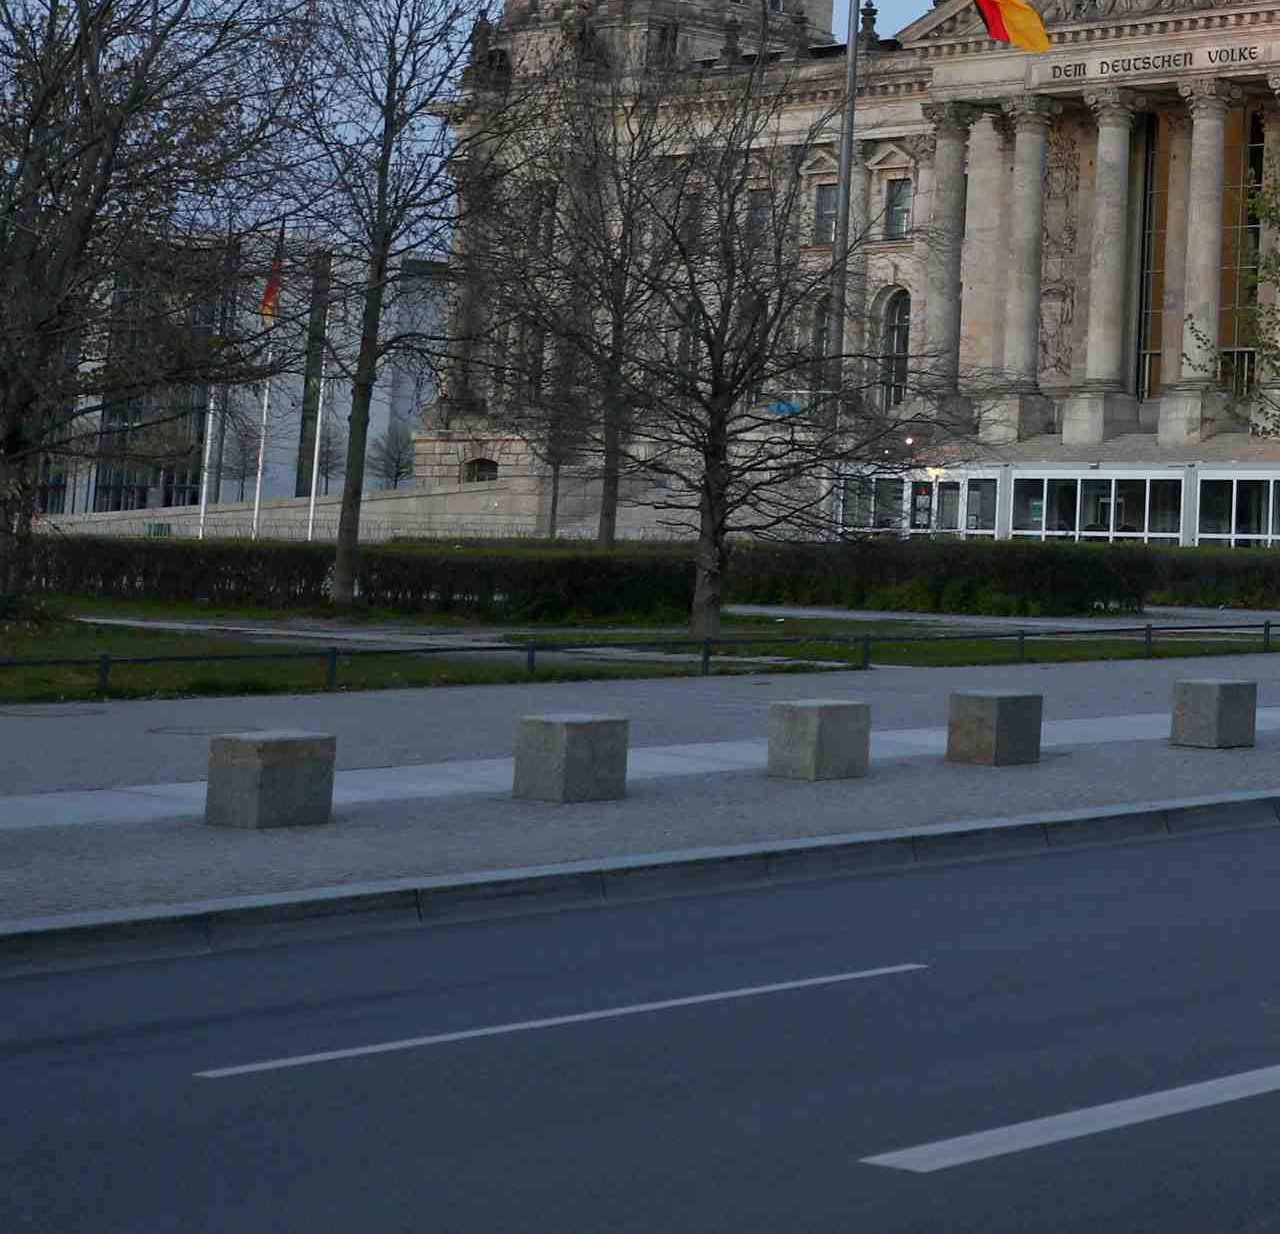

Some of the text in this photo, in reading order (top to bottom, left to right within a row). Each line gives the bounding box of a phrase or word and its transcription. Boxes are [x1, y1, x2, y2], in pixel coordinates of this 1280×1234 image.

[1052, 46, 1259, 79] DEM DEUTSCHEN VOLKE
